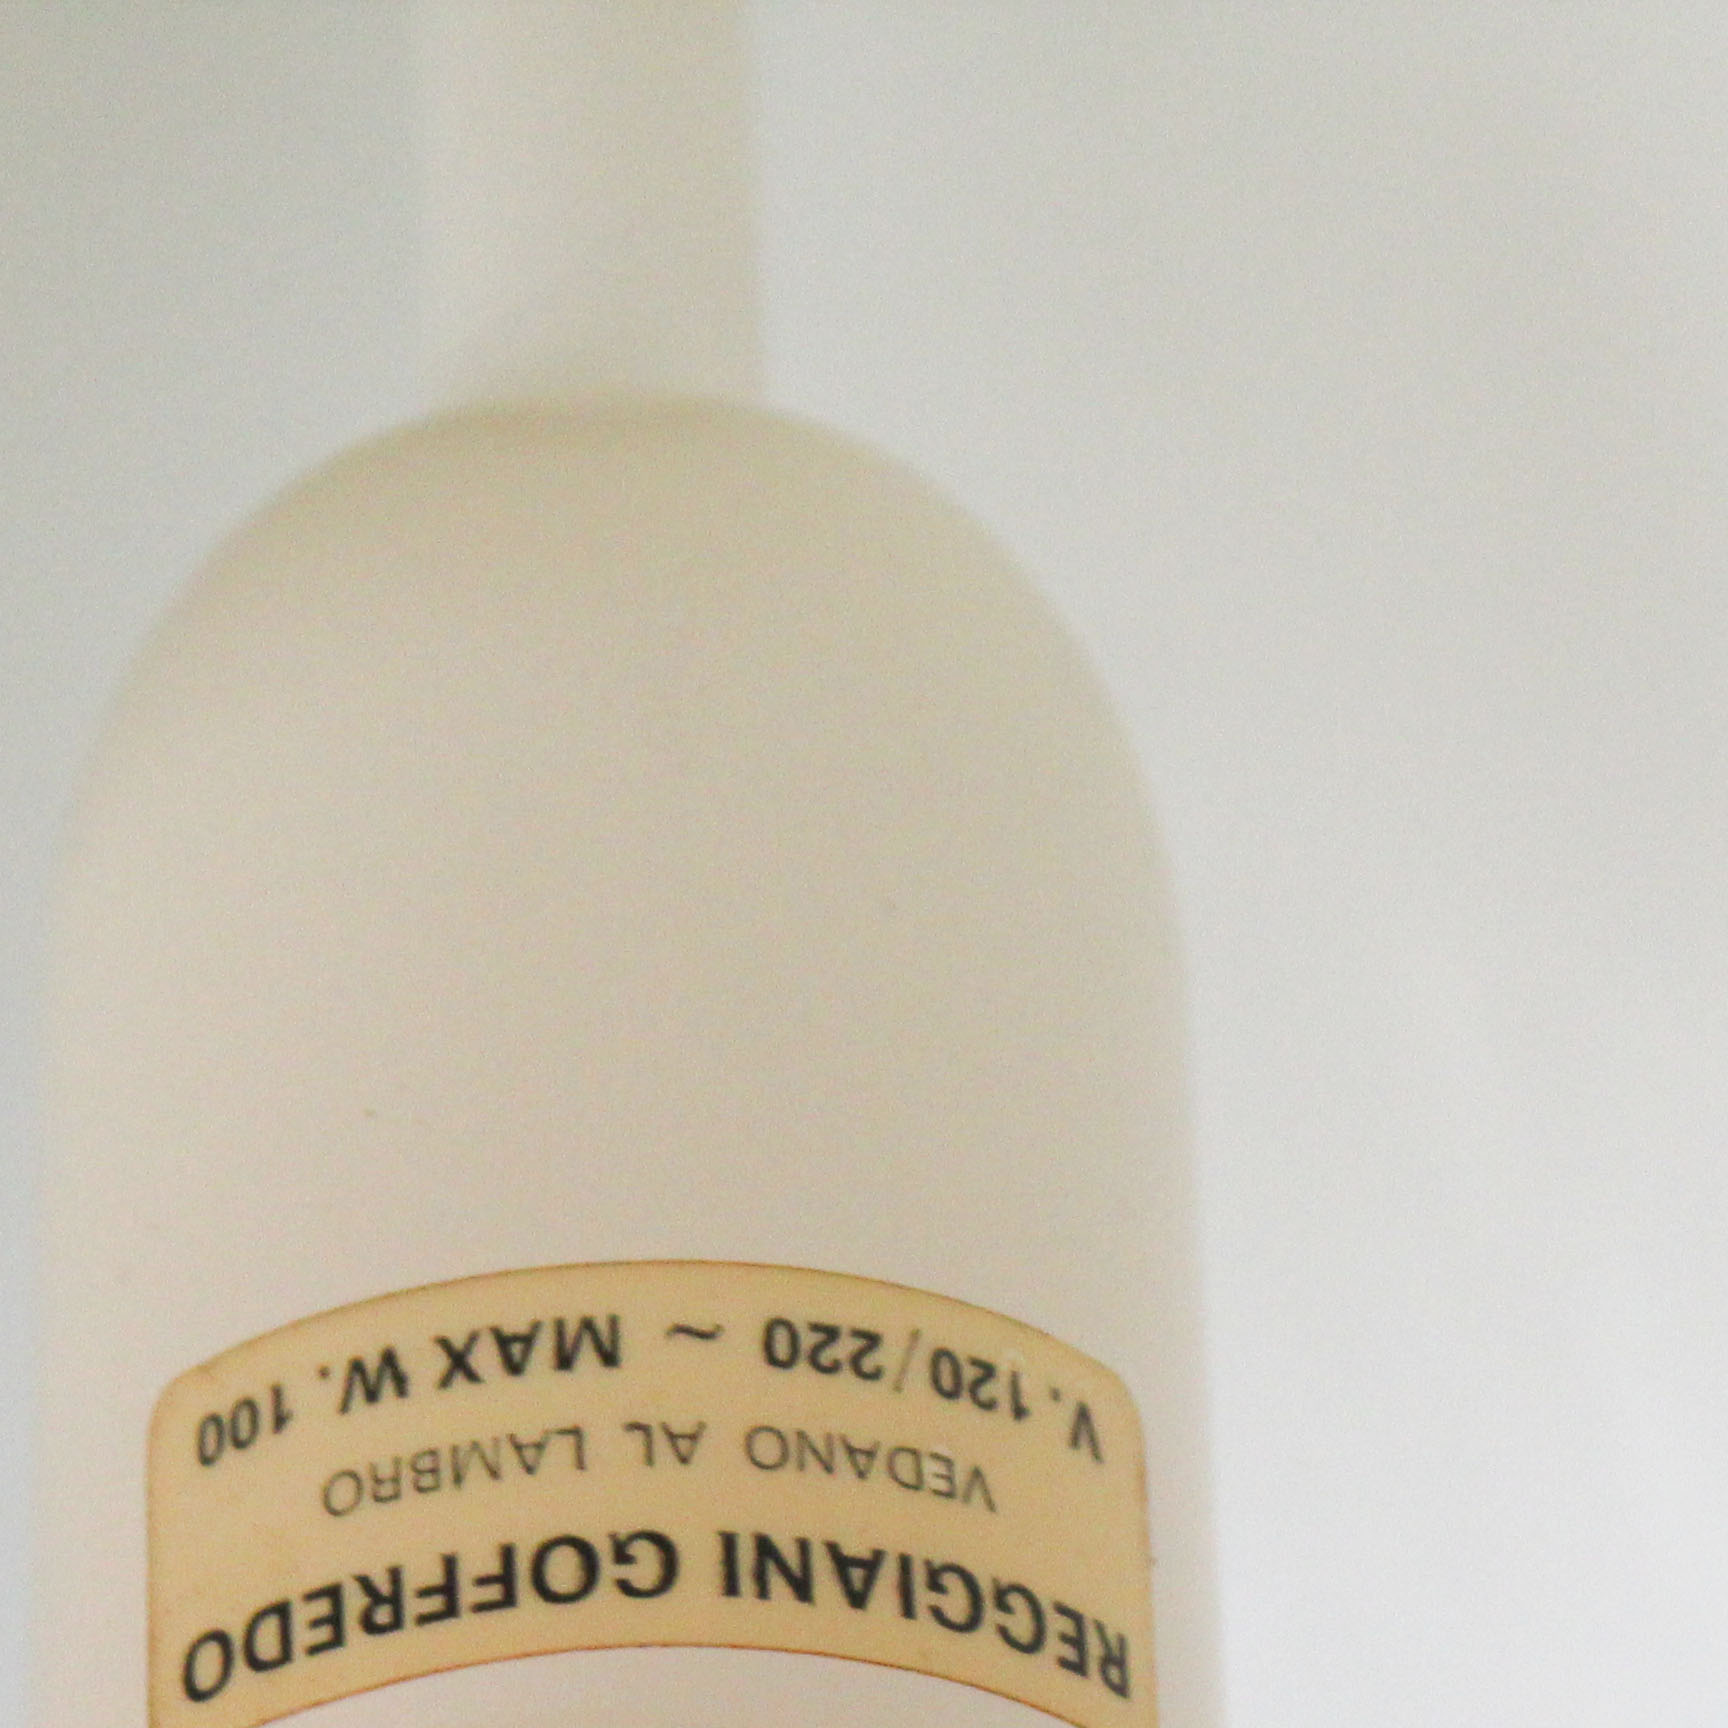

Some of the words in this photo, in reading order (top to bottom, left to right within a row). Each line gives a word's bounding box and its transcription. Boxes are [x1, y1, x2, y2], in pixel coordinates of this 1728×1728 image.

[318, 1345, 408, 1415] W.
[435, 1314, 623, 1389] MAX
[765, 1317, 1027, 1420] 120/220
[198, 1384, 293, 1467] 100
[625, 1422, 707, 1468] AL
[745, 1425, 996, 1513] VEDANO
[322, 1425, 587, 1517] LAMBRO
[182, 1528, 678, 1704] GOFFREDO
[718, 1530, 1131, 1699] REGGIANI
